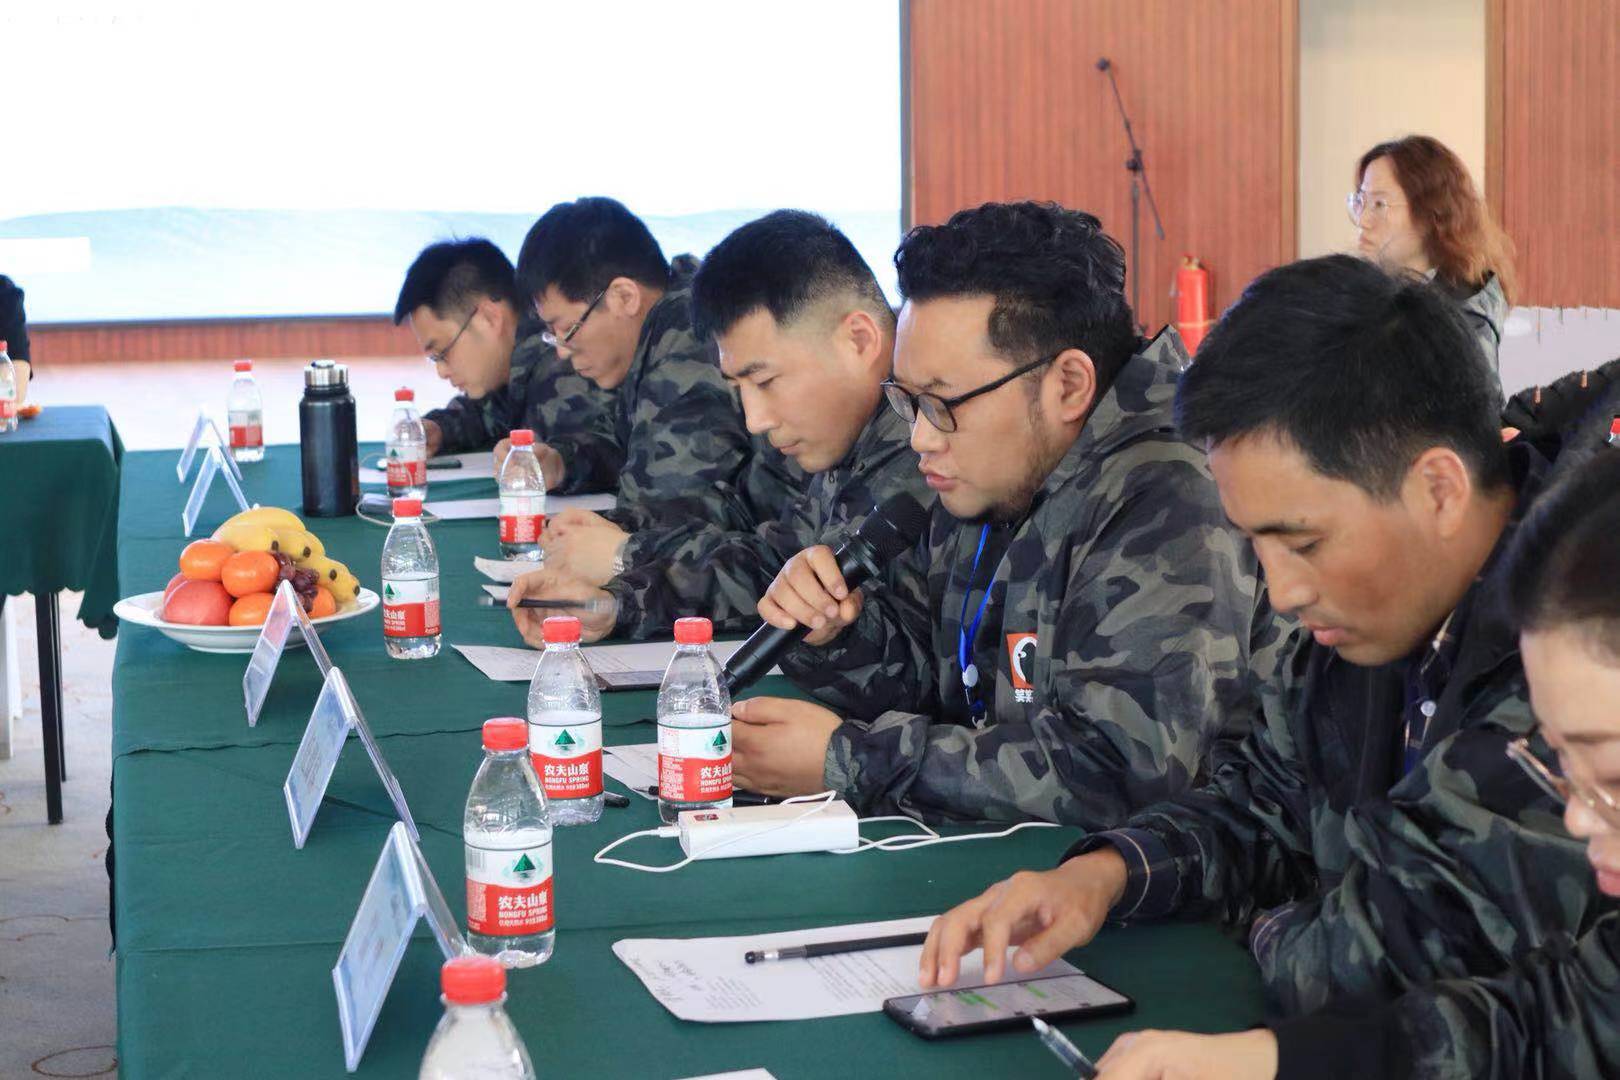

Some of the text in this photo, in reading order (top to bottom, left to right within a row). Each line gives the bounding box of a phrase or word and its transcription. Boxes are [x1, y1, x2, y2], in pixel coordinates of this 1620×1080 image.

[544, 761, 590, 777] 农夫山泉
[498, 889, 548, 910] 农夫山泉
